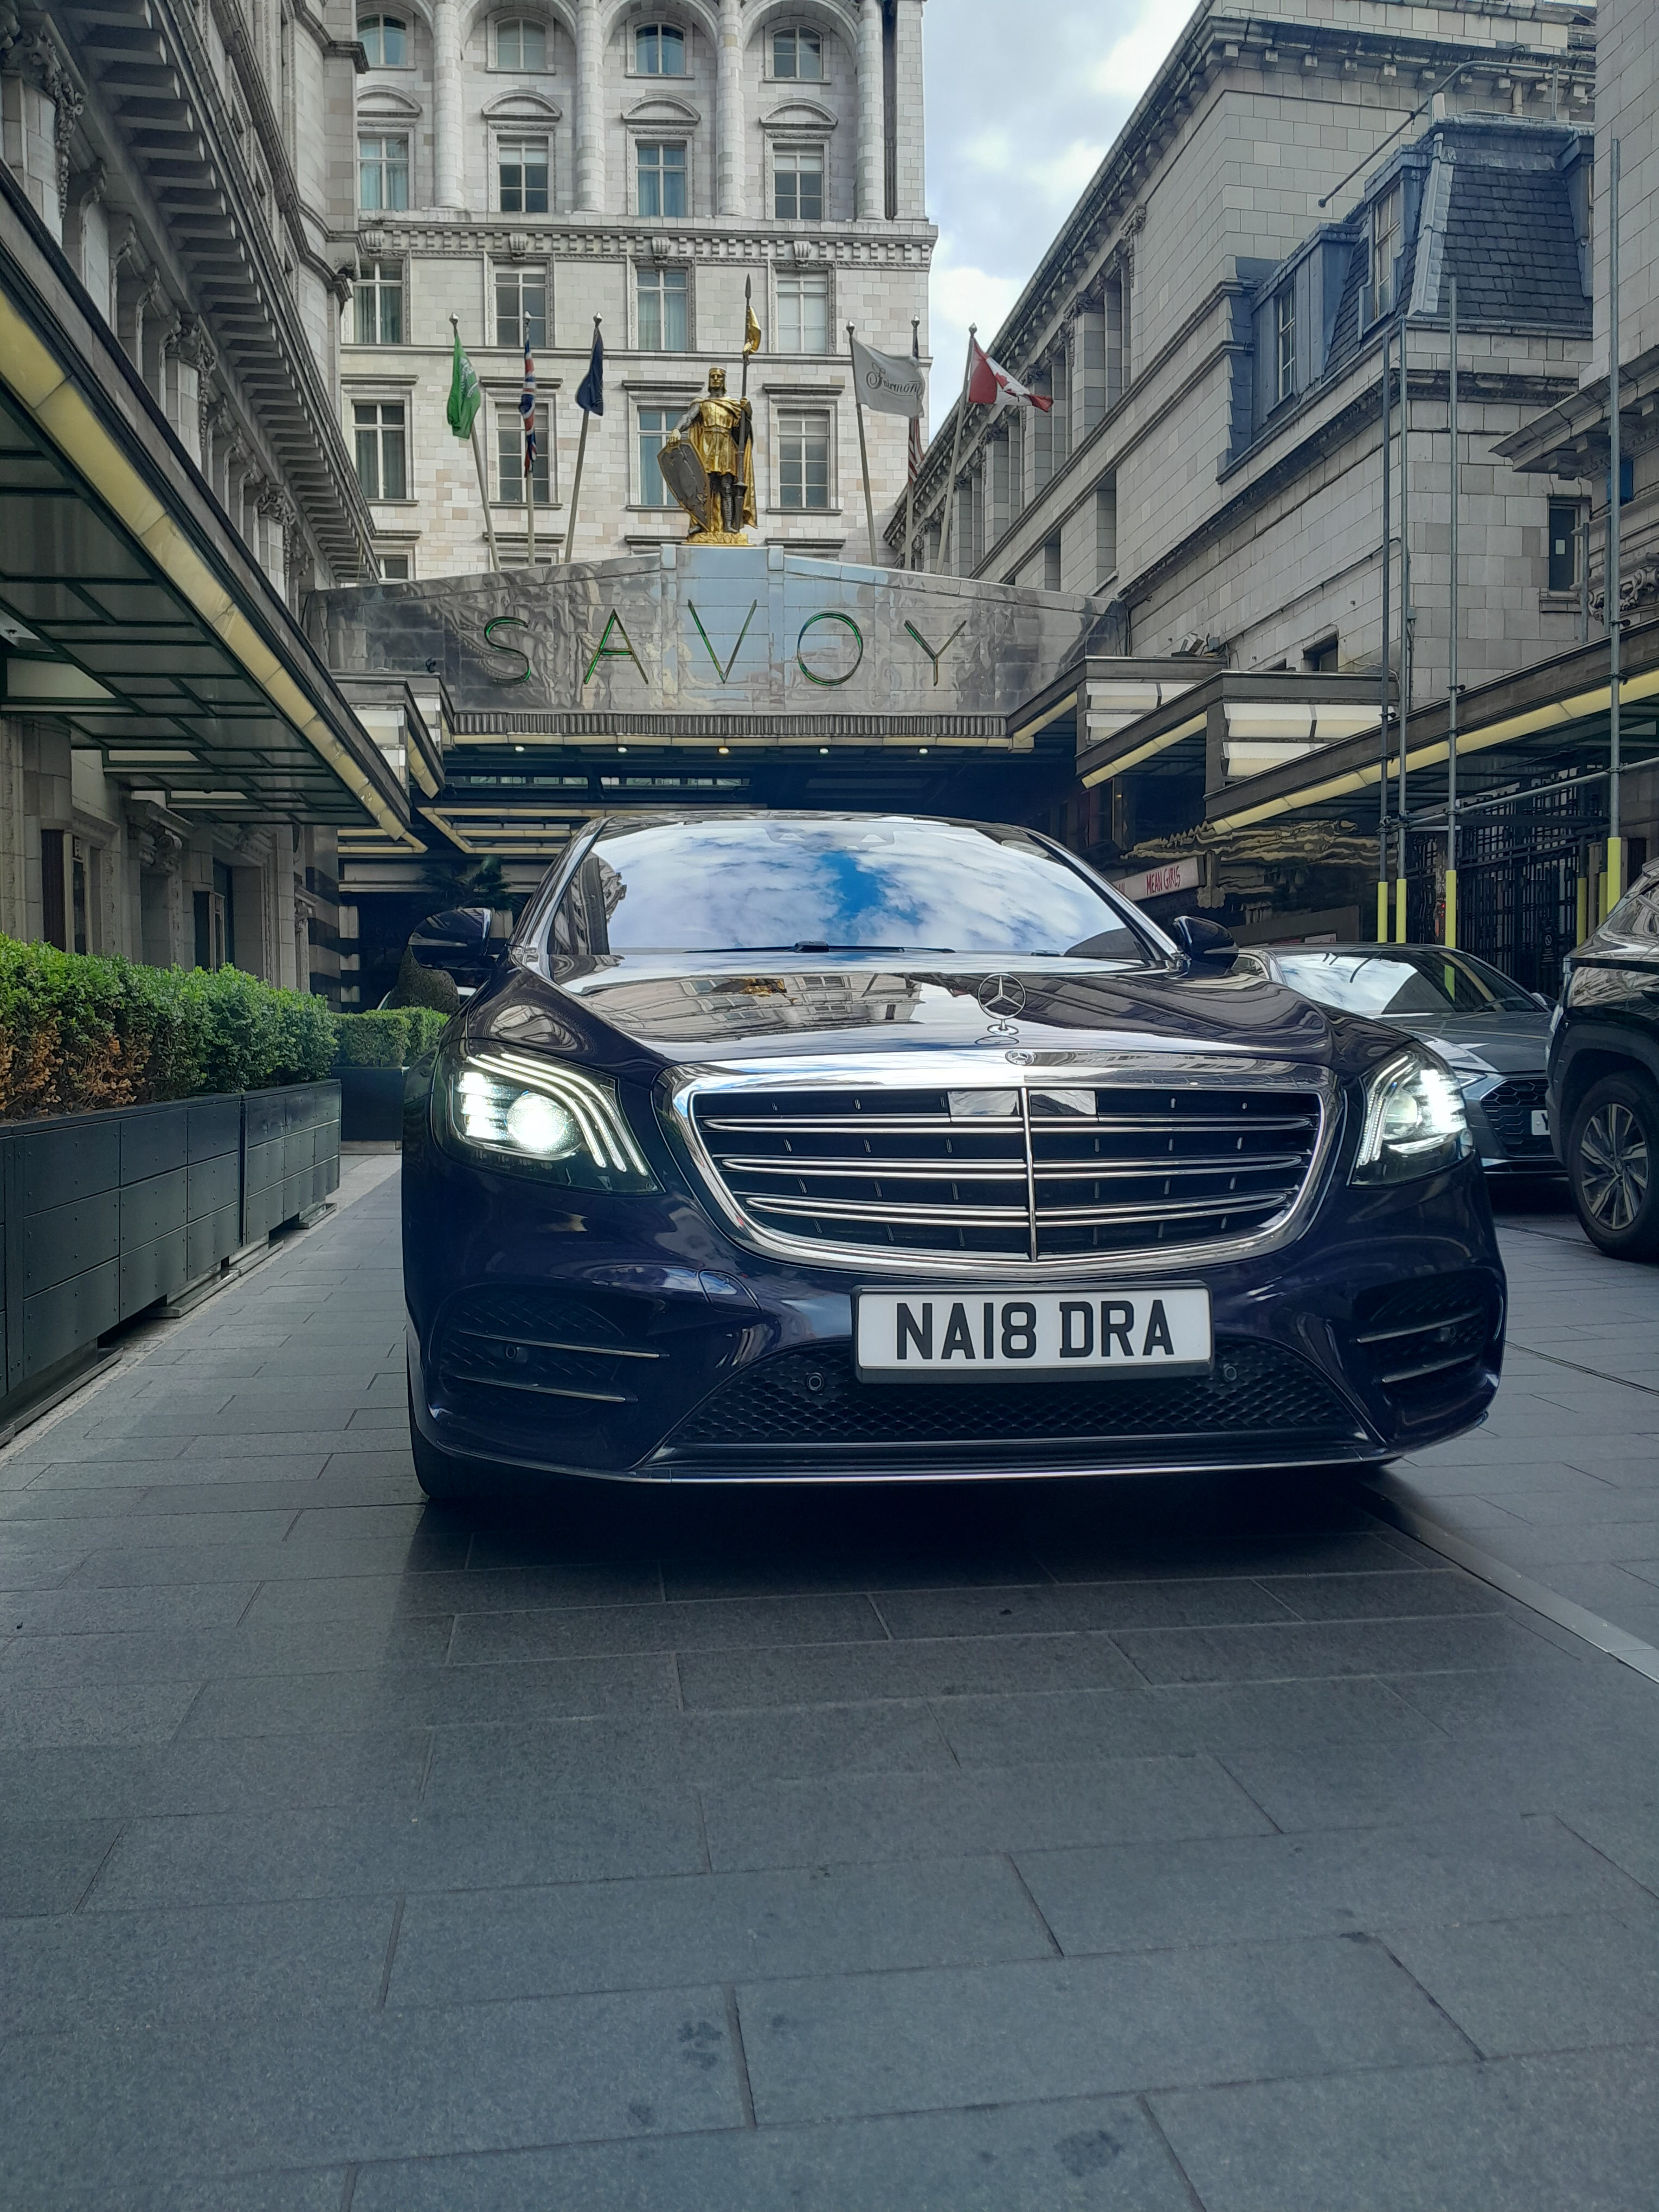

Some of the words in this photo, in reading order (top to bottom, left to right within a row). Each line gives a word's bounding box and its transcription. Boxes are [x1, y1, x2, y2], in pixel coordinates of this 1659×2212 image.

[484, 599, 967, 687] SAVOY
[1146, 871, 1163, 895] MEAN
[1163, 866, 1181, 890] GIRLS
[896, 1302, 1037, 1360] NA18
[1059, 1299, 1174, 1358] DRA
